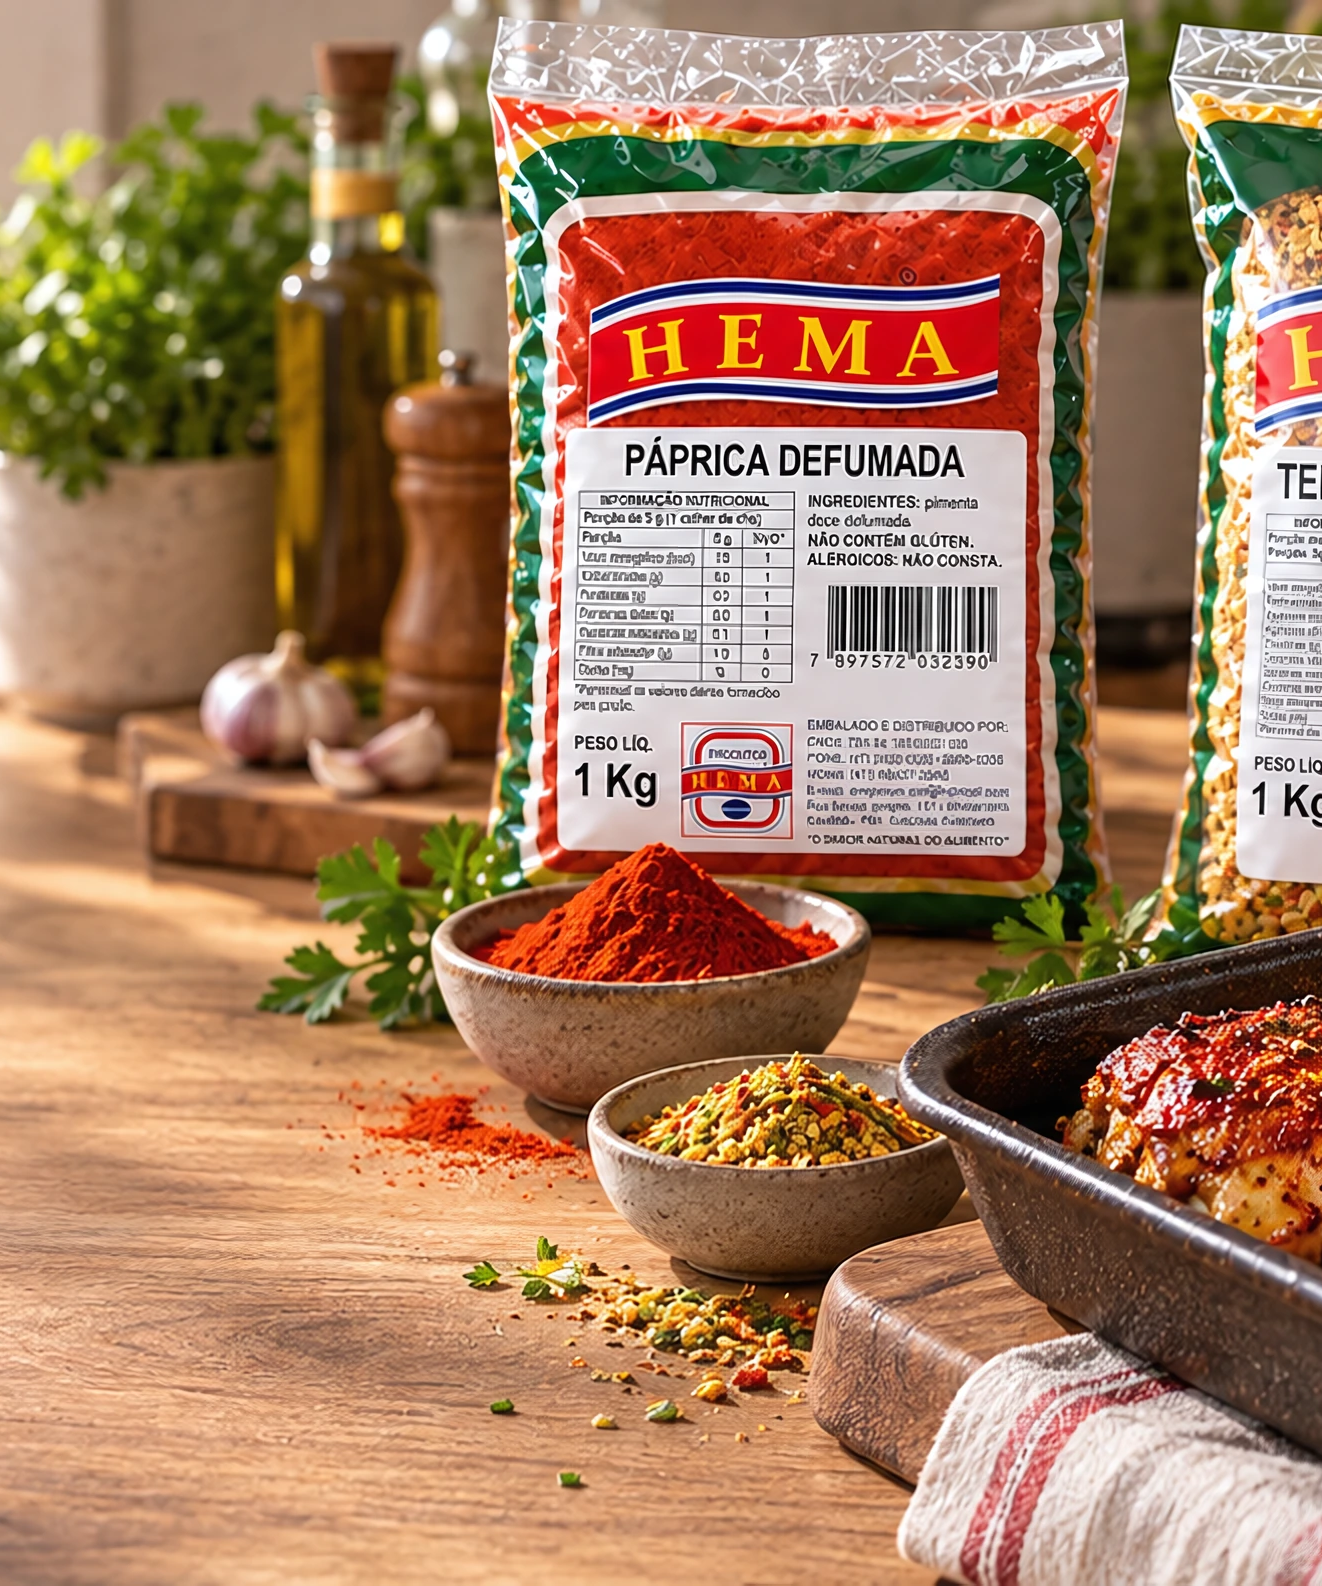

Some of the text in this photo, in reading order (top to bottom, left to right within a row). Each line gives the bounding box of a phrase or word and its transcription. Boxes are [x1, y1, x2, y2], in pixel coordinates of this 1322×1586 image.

[622, 313, 960, 383] HEMA
[624, 435, 966, 478] PÁPRICA DEFUMADA
[808, 494, 920, 509] INGREDIENTES:
[808, 531, 840, 548] NÃO
[937, 554, 1003, 568] CONSTA.
[810, 653, 989, 670] 7 897572 032390
[574, 735, 618, 751] PESO
[1254, 756, 1296, 772] PESO
[574, 762, 656, 808] 1 Kg
[1252, 781, 1266, 815] 1
